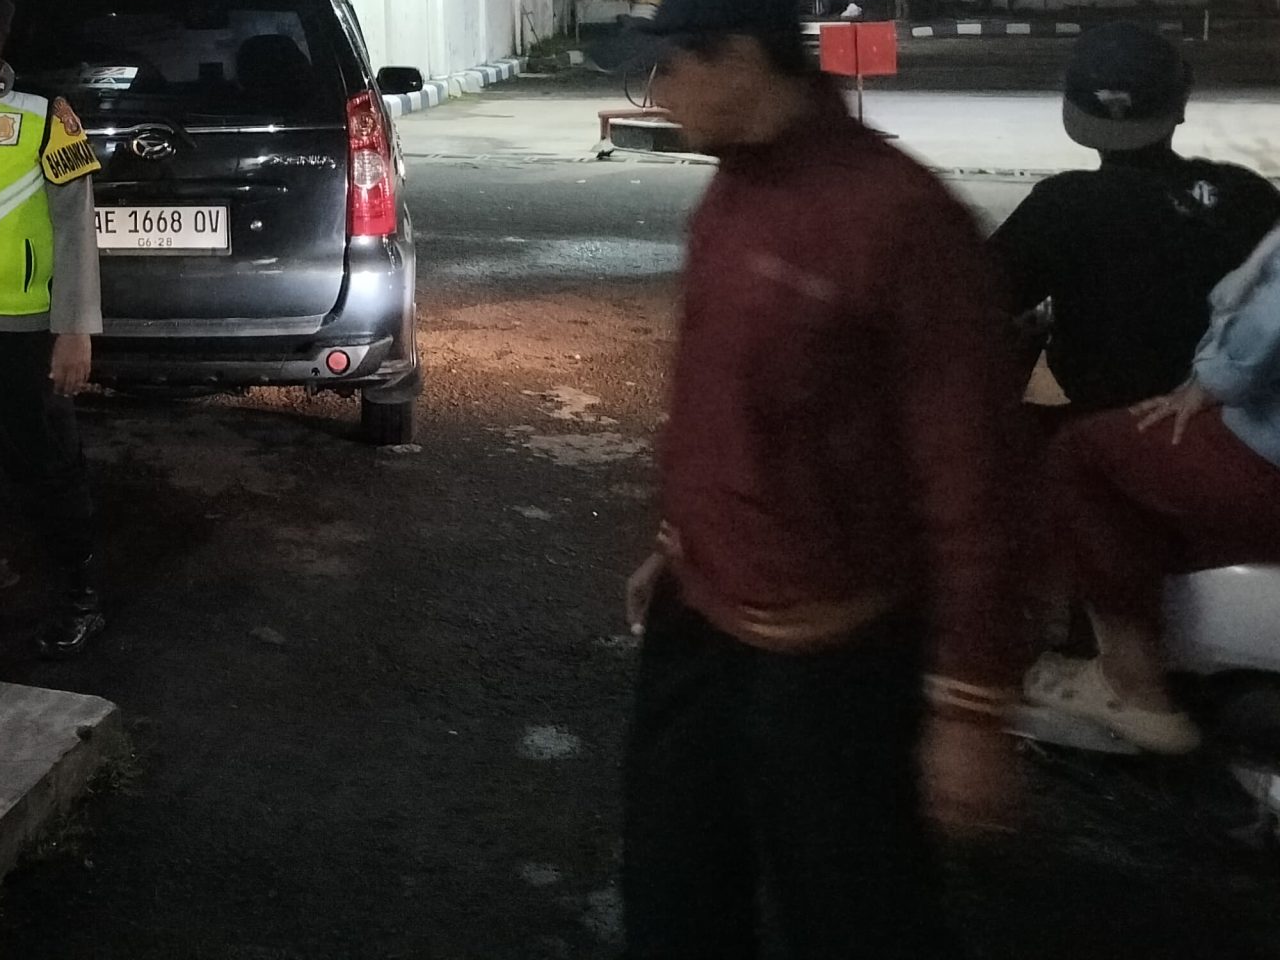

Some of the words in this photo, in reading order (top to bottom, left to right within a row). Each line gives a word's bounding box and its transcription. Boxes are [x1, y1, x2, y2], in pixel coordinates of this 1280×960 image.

[95, 210, 117, 234] AE
[128, 209, 183, 233] 1668
[194, 209, 220, 233] OV
